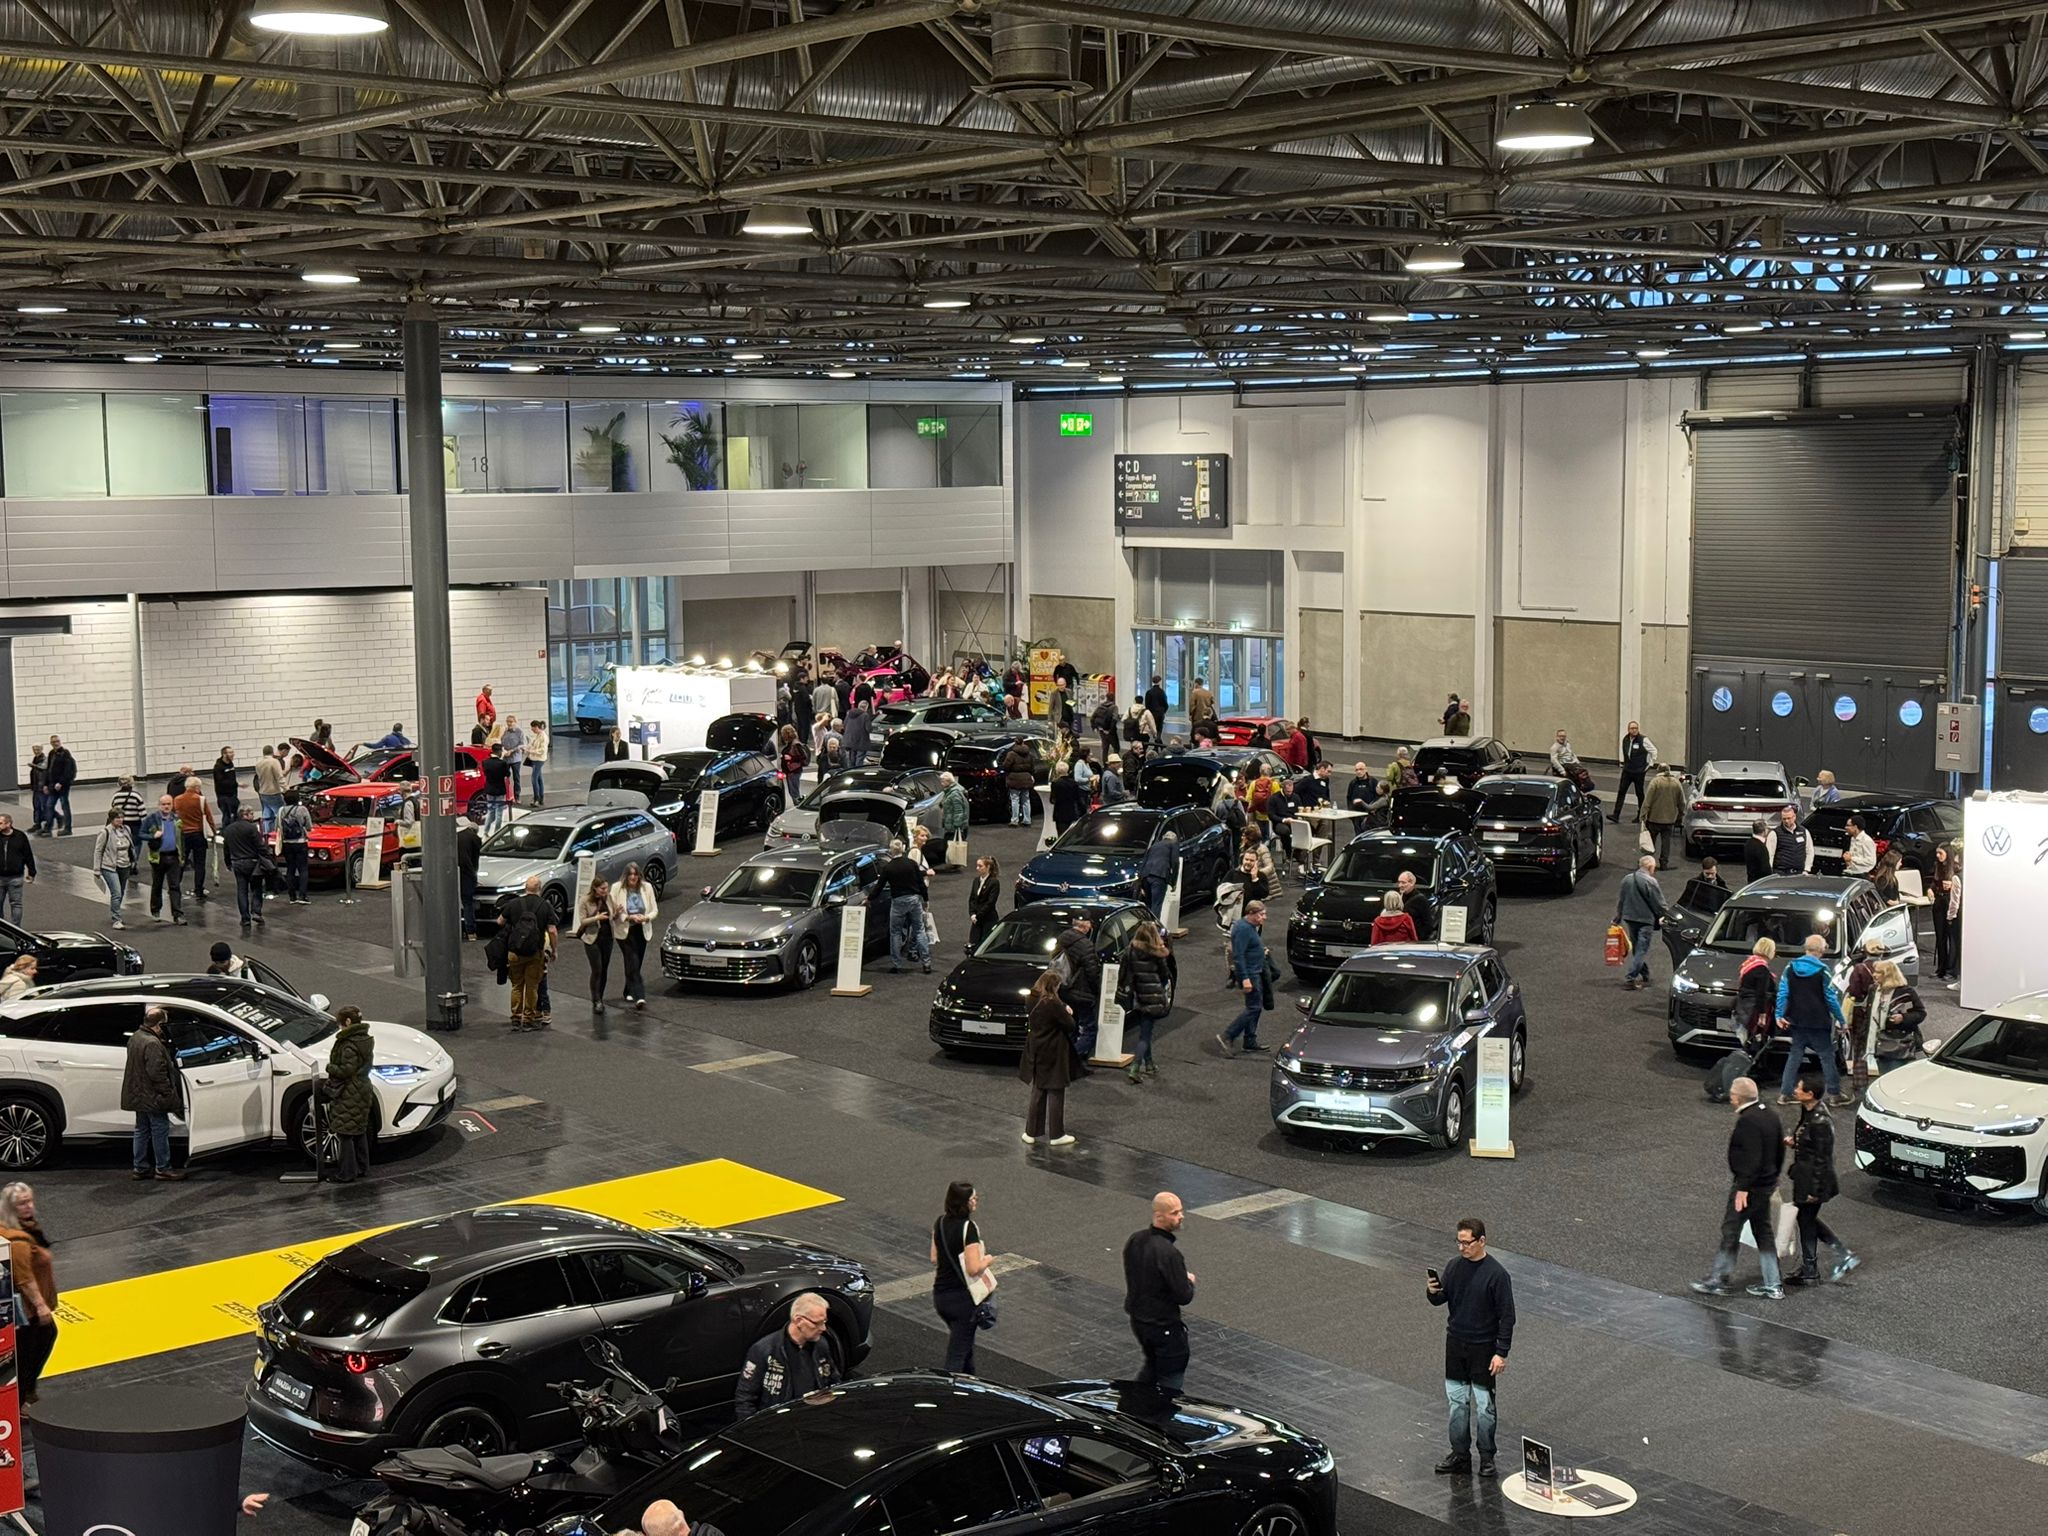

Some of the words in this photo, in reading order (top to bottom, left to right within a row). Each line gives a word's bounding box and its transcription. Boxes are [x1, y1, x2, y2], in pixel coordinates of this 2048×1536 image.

[472, 456, 488, 473] 18
[1125, 460, 1131, 473] C
[1133, 460, 1140, 473] D
[765, 1371, 784, 1381] CAMP
[275, 1378, 291, 1392] MAZDA
